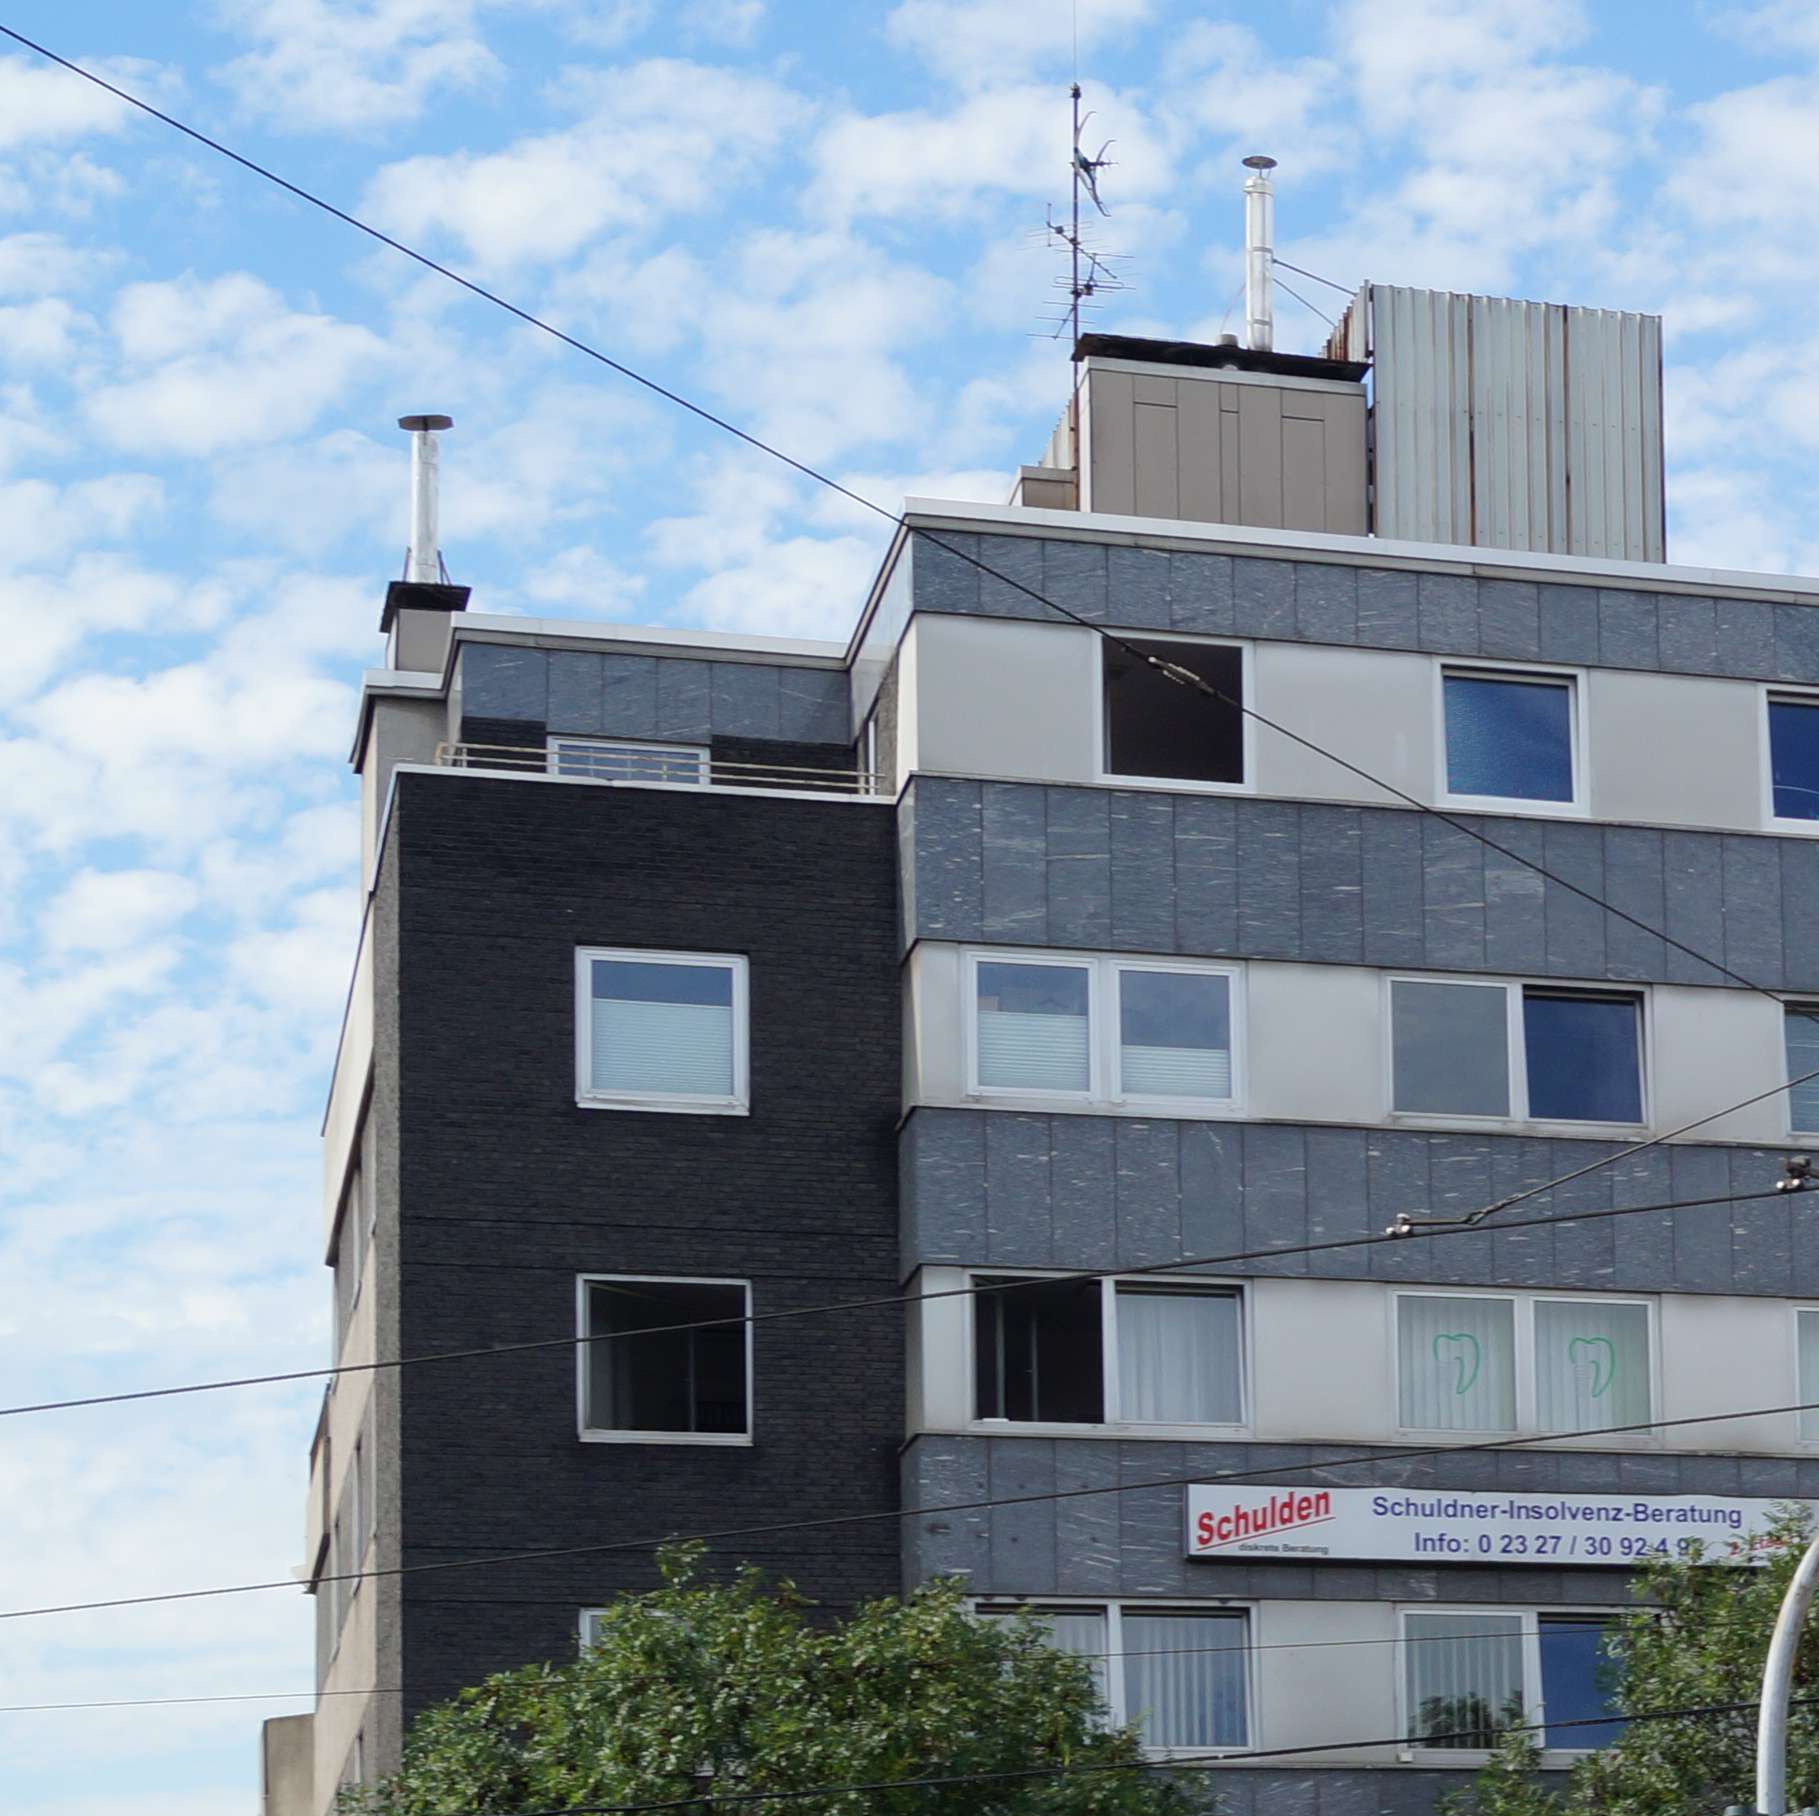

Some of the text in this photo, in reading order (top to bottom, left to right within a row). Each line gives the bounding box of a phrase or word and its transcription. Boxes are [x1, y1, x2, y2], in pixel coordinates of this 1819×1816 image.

[1196, 1491, 1331, 1546] Schulden
[1372, 1496, 1742, 1529] Schuldner-Insolvenz-Beratung
[1281, 1543, 1330, 1556] Beratung
[1414, 1532, 1470, 1553] Info:
[1477, 1534, 1492, 1554] 0
[1499, 1534, 1529, 1555] 23
[1534, 1535, 1563, 1555] 27
[1584, 1536, 1612, 1556] 30
